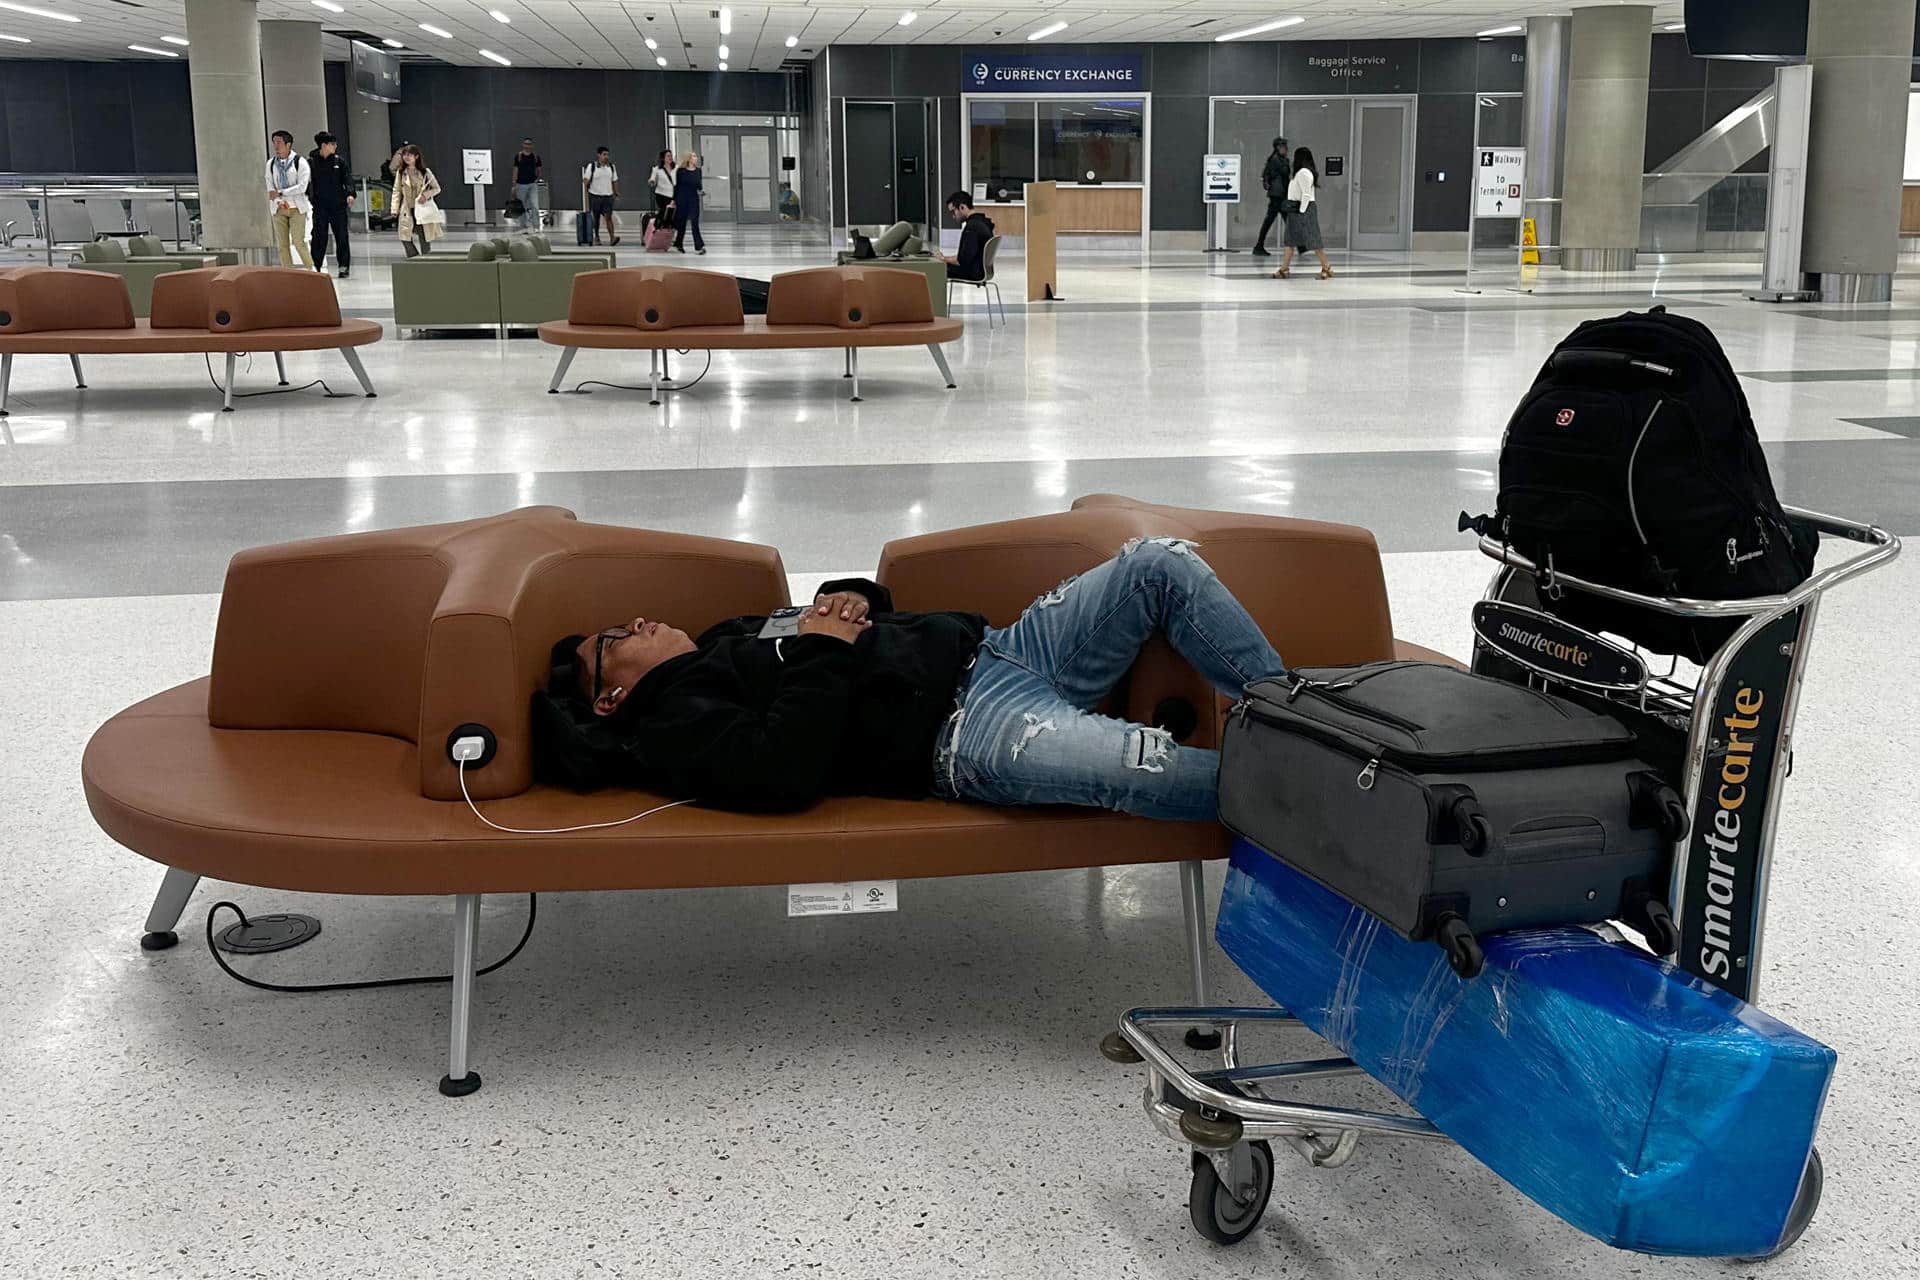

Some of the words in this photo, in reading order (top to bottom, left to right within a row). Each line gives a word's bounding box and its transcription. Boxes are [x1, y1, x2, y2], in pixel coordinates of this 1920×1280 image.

[1308, 56, 1349, 67] Baggage
[1352, 55, 1386, 65] Service
[994, 69, 1061, 81] CURRENCY
[1065, 69, 1133, 81] EXCHANGE
[1331, 67, 1363, 77] Office
[1495, 155, 1521, 165] Walkway
[1480, 187, 1508, 196] Terminal
[1509, 185, 1520, 197] D
[1499, 622, 1588, 667] smartecarte
[1701, 687, 1764, 980] smartecarte
